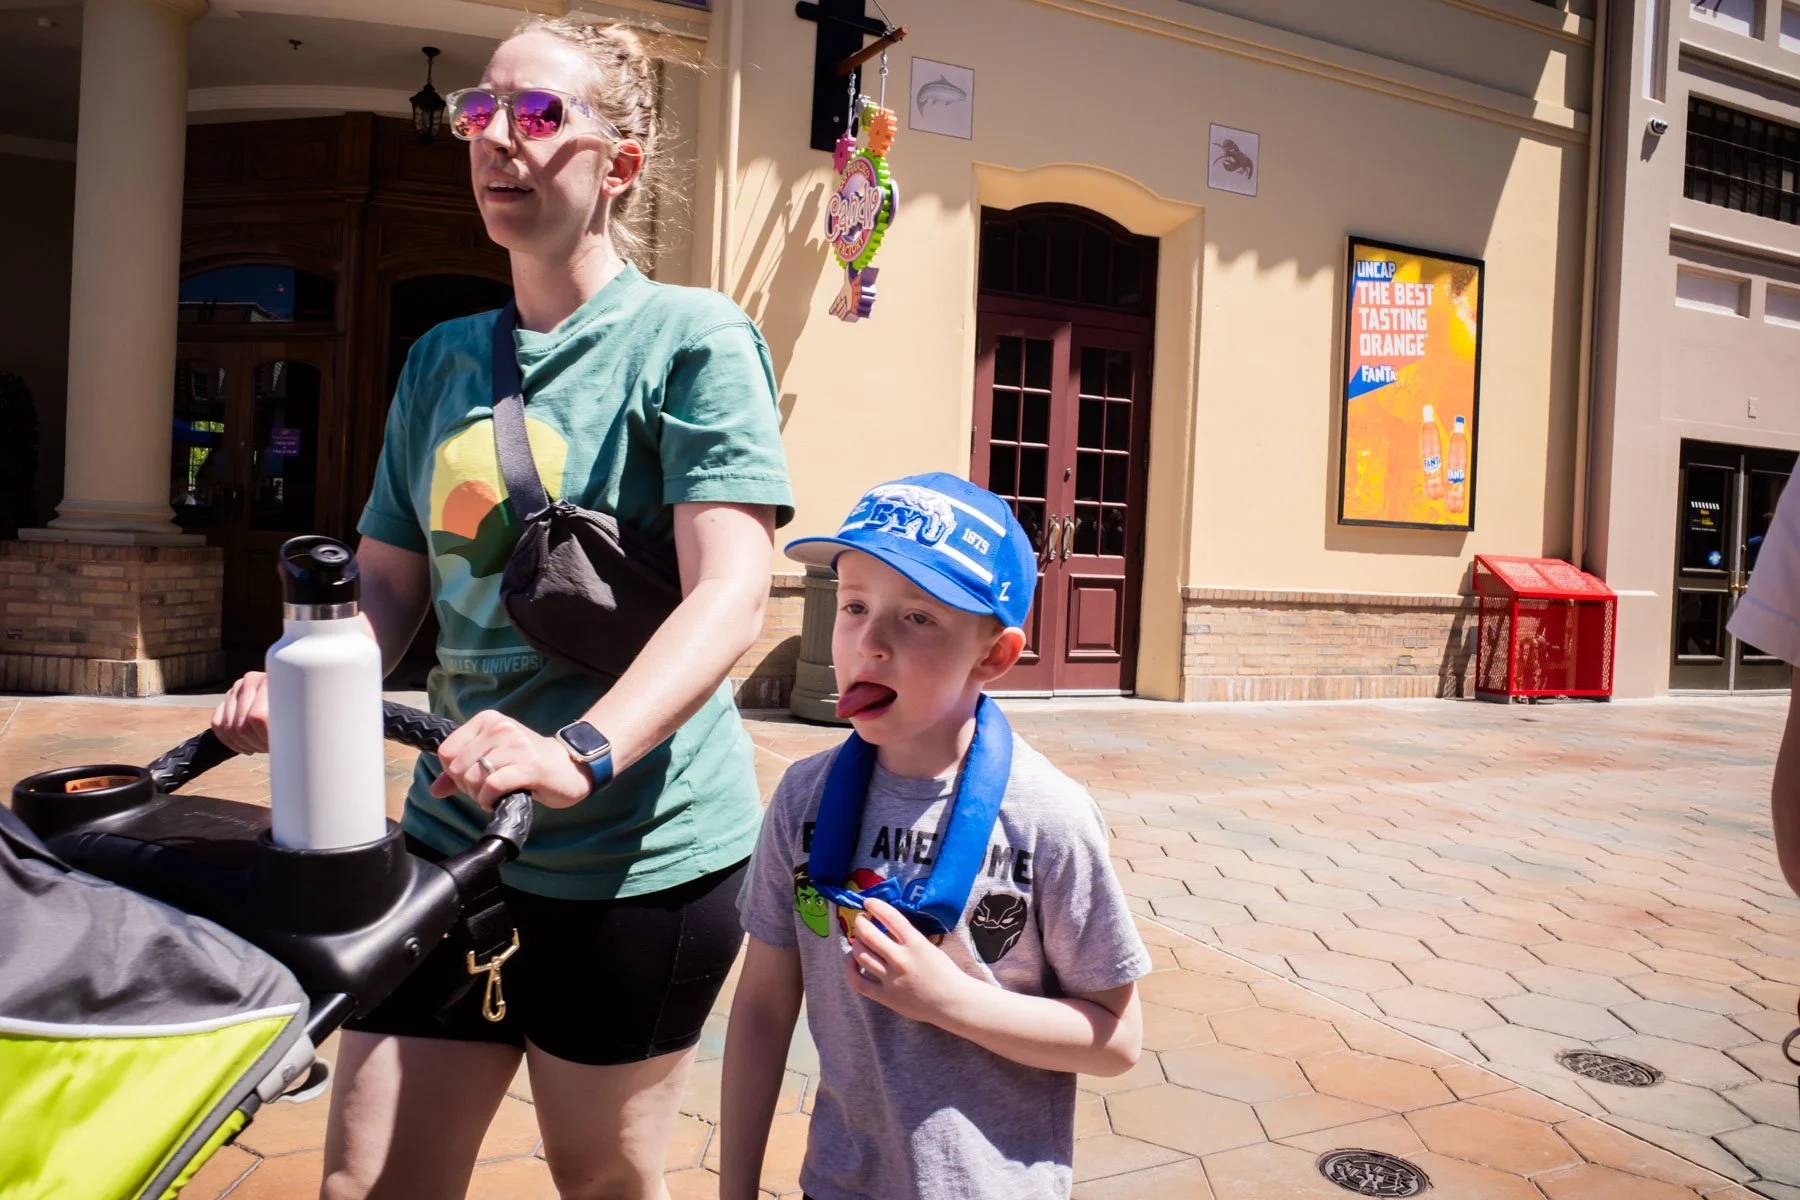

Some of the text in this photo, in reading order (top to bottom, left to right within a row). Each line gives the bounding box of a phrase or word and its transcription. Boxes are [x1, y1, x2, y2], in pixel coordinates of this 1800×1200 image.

[825, 180, 883, 243] Candy
[839, 234, 865, 256] FACTORY
[1357, 261, 1396, 278] UNCAP
[1357, 282, 1434, 306] THE BEST
[1359, 307, 1427, 331] TASTING
[862, 502, 949, 547] BYU
[961, 527, 991, 556] 1875
[870, 826, 1034, 885] AWEME
[1333, 1161, 1412, 1190] WATER
